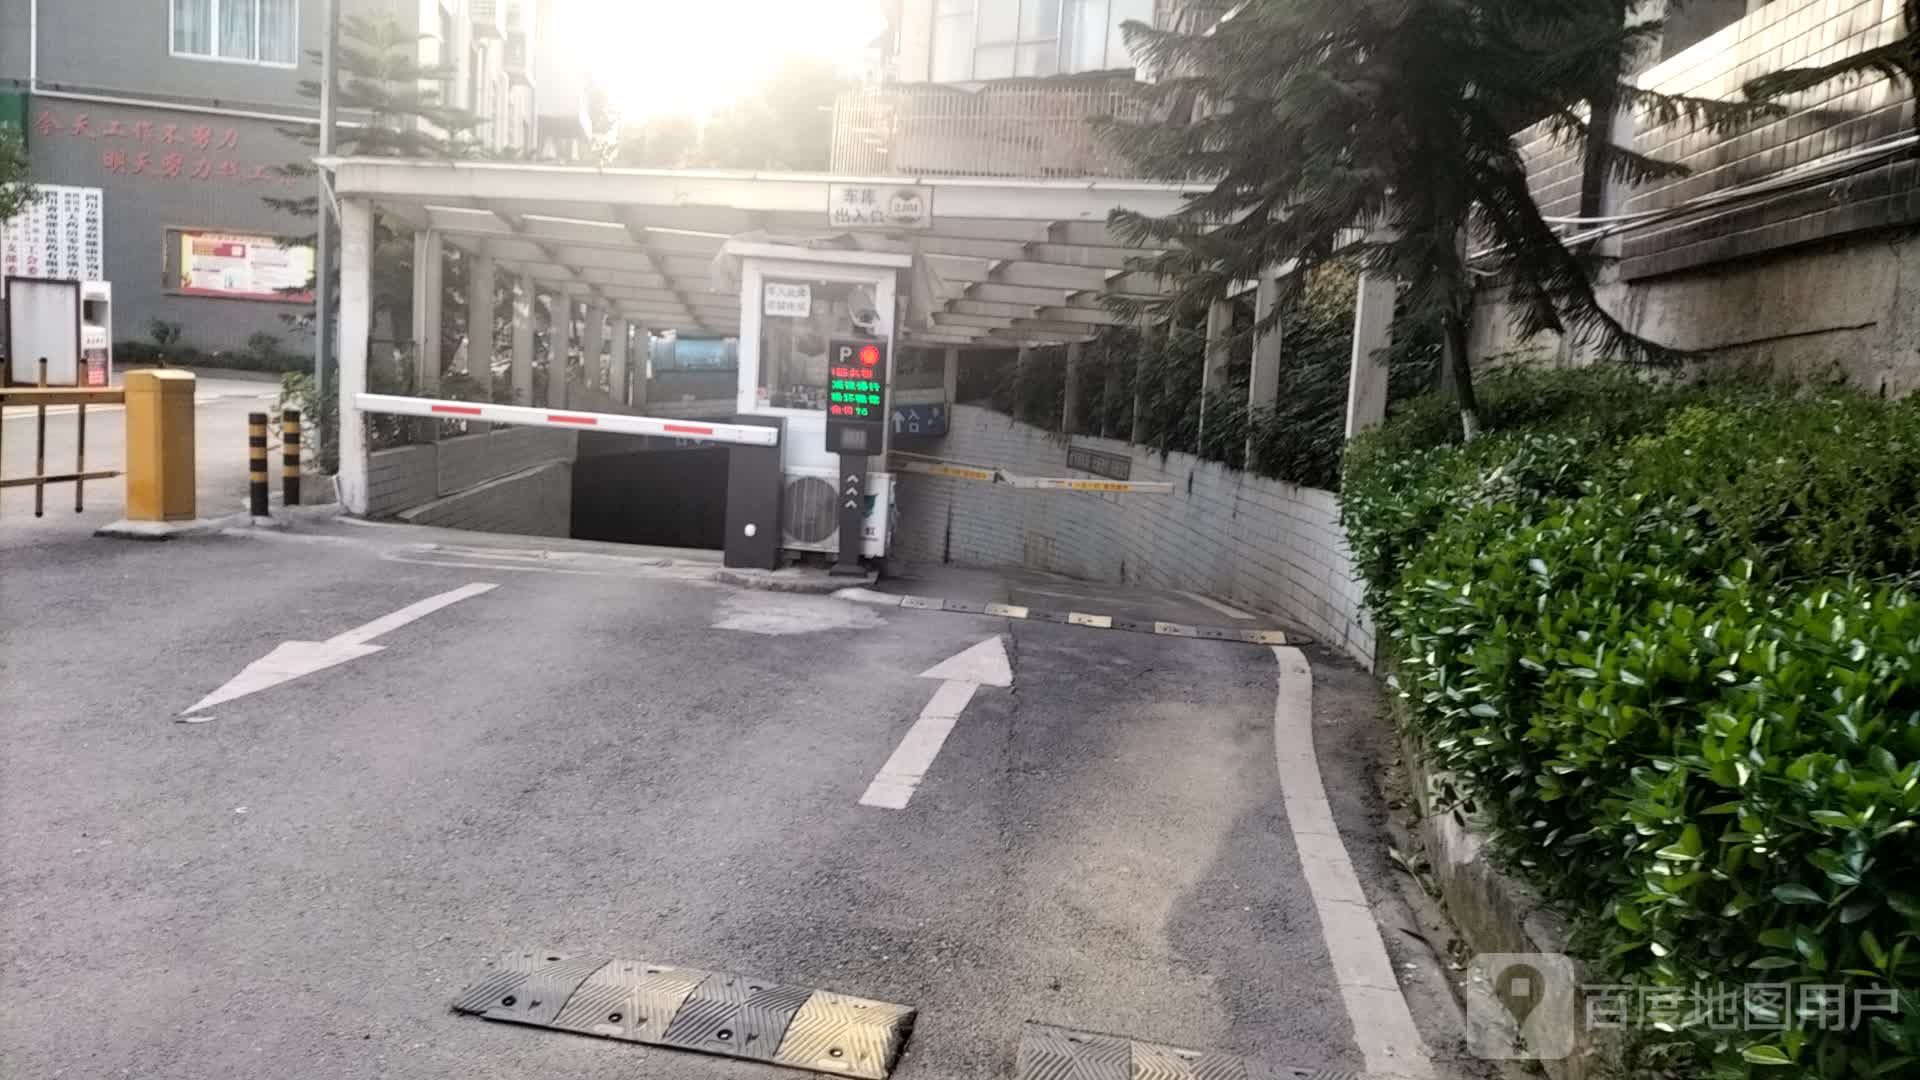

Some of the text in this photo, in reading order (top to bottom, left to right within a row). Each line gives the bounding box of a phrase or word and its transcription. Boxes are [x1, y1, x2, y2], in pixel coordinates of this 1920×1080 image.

[34, 110, 240, 150] 今天工作不努力
[844, 187, 876, 205] 车库
[835, 208, 884, 224] 出入口
[839, 346, 852, 362] P
[907, 408, 920, 433] 入口
